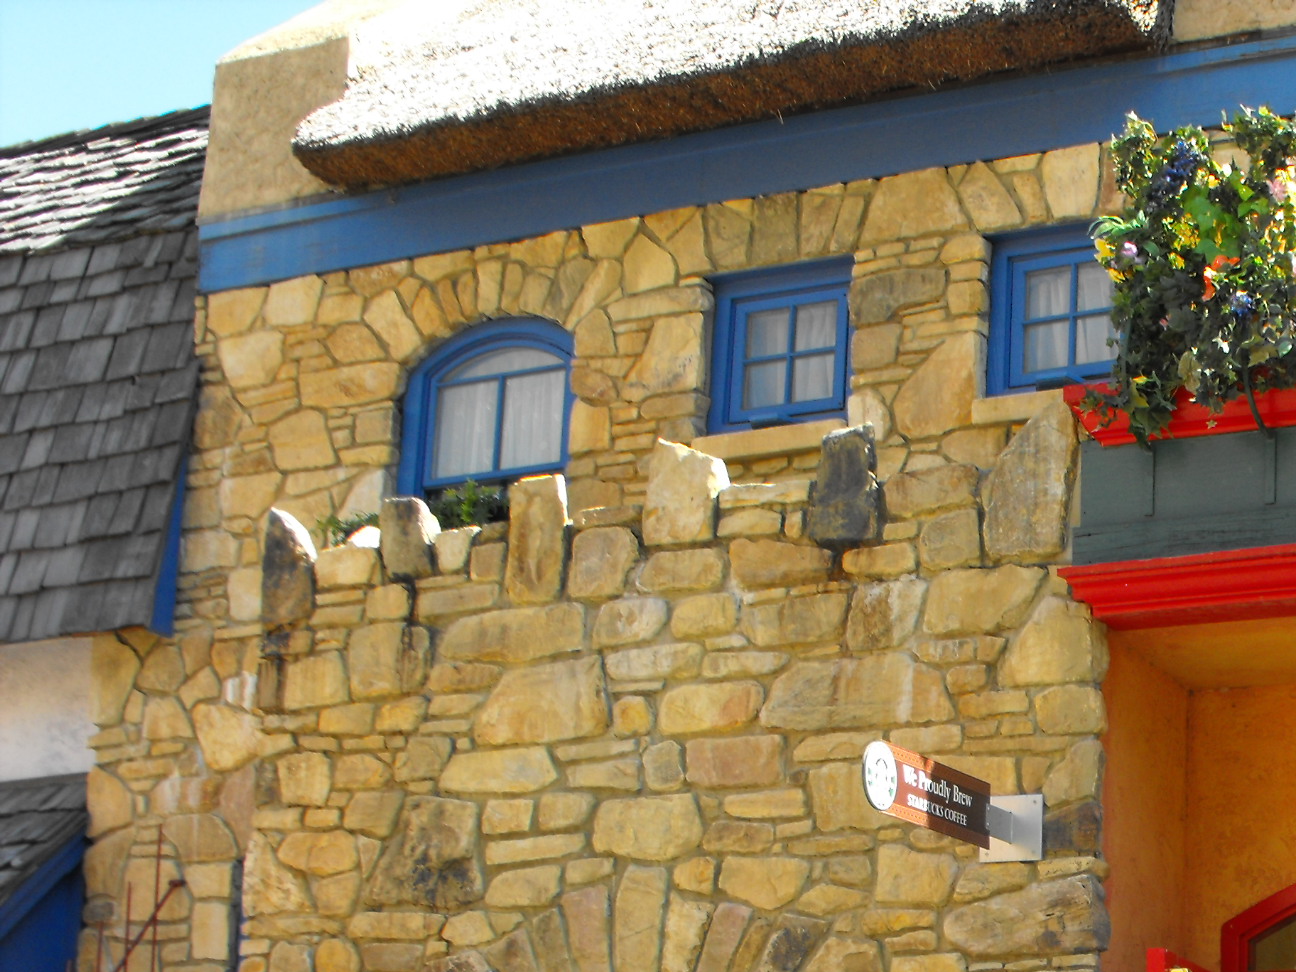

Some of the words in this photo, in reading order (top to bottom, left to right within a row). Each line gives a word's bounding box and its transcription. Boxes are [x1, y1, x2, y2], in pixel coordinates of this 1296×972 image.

[902, 764, 917, 787] We
[918, 770, 951, 804] Proudly
[953, 784, 973, 807] Brew
[907, 793, 944, 818] STARBUCKS
[944, 808, 968, 826] COFFEE
